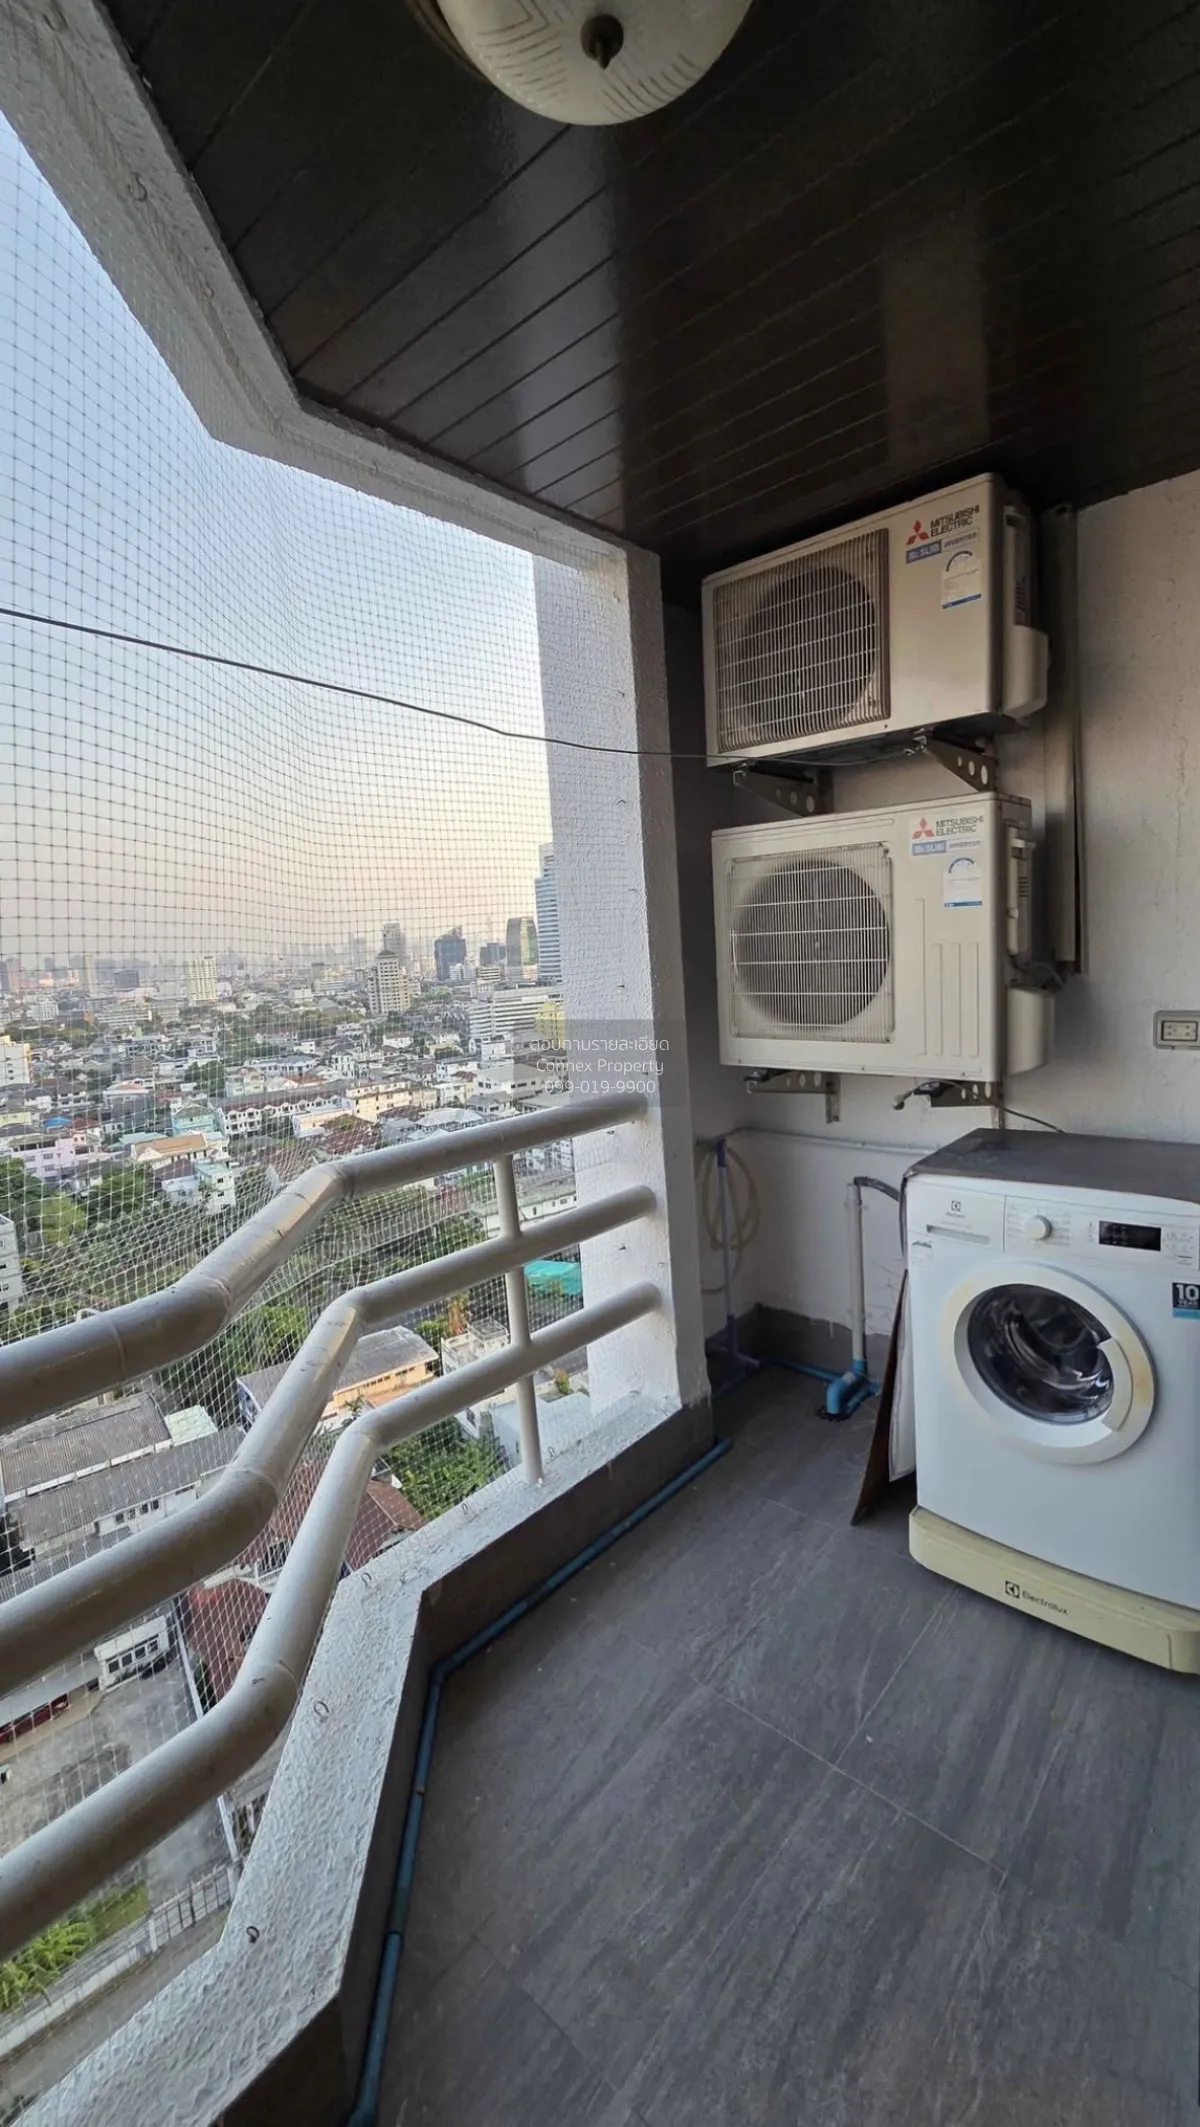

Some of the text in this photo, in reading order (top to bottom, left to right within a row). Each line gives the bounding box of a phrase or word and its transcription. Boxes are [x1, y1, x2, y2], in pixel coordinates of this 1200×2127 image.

[930, 517, 974, 537] ELECTRIC
[936, 815, 984, 828] MITSUBISHI
[936, 824, 977, 837] ELECTRIC
[1176, 1283, 1200, 1301] 10
[1021, 1590, 1070, 1616] Electrolux
